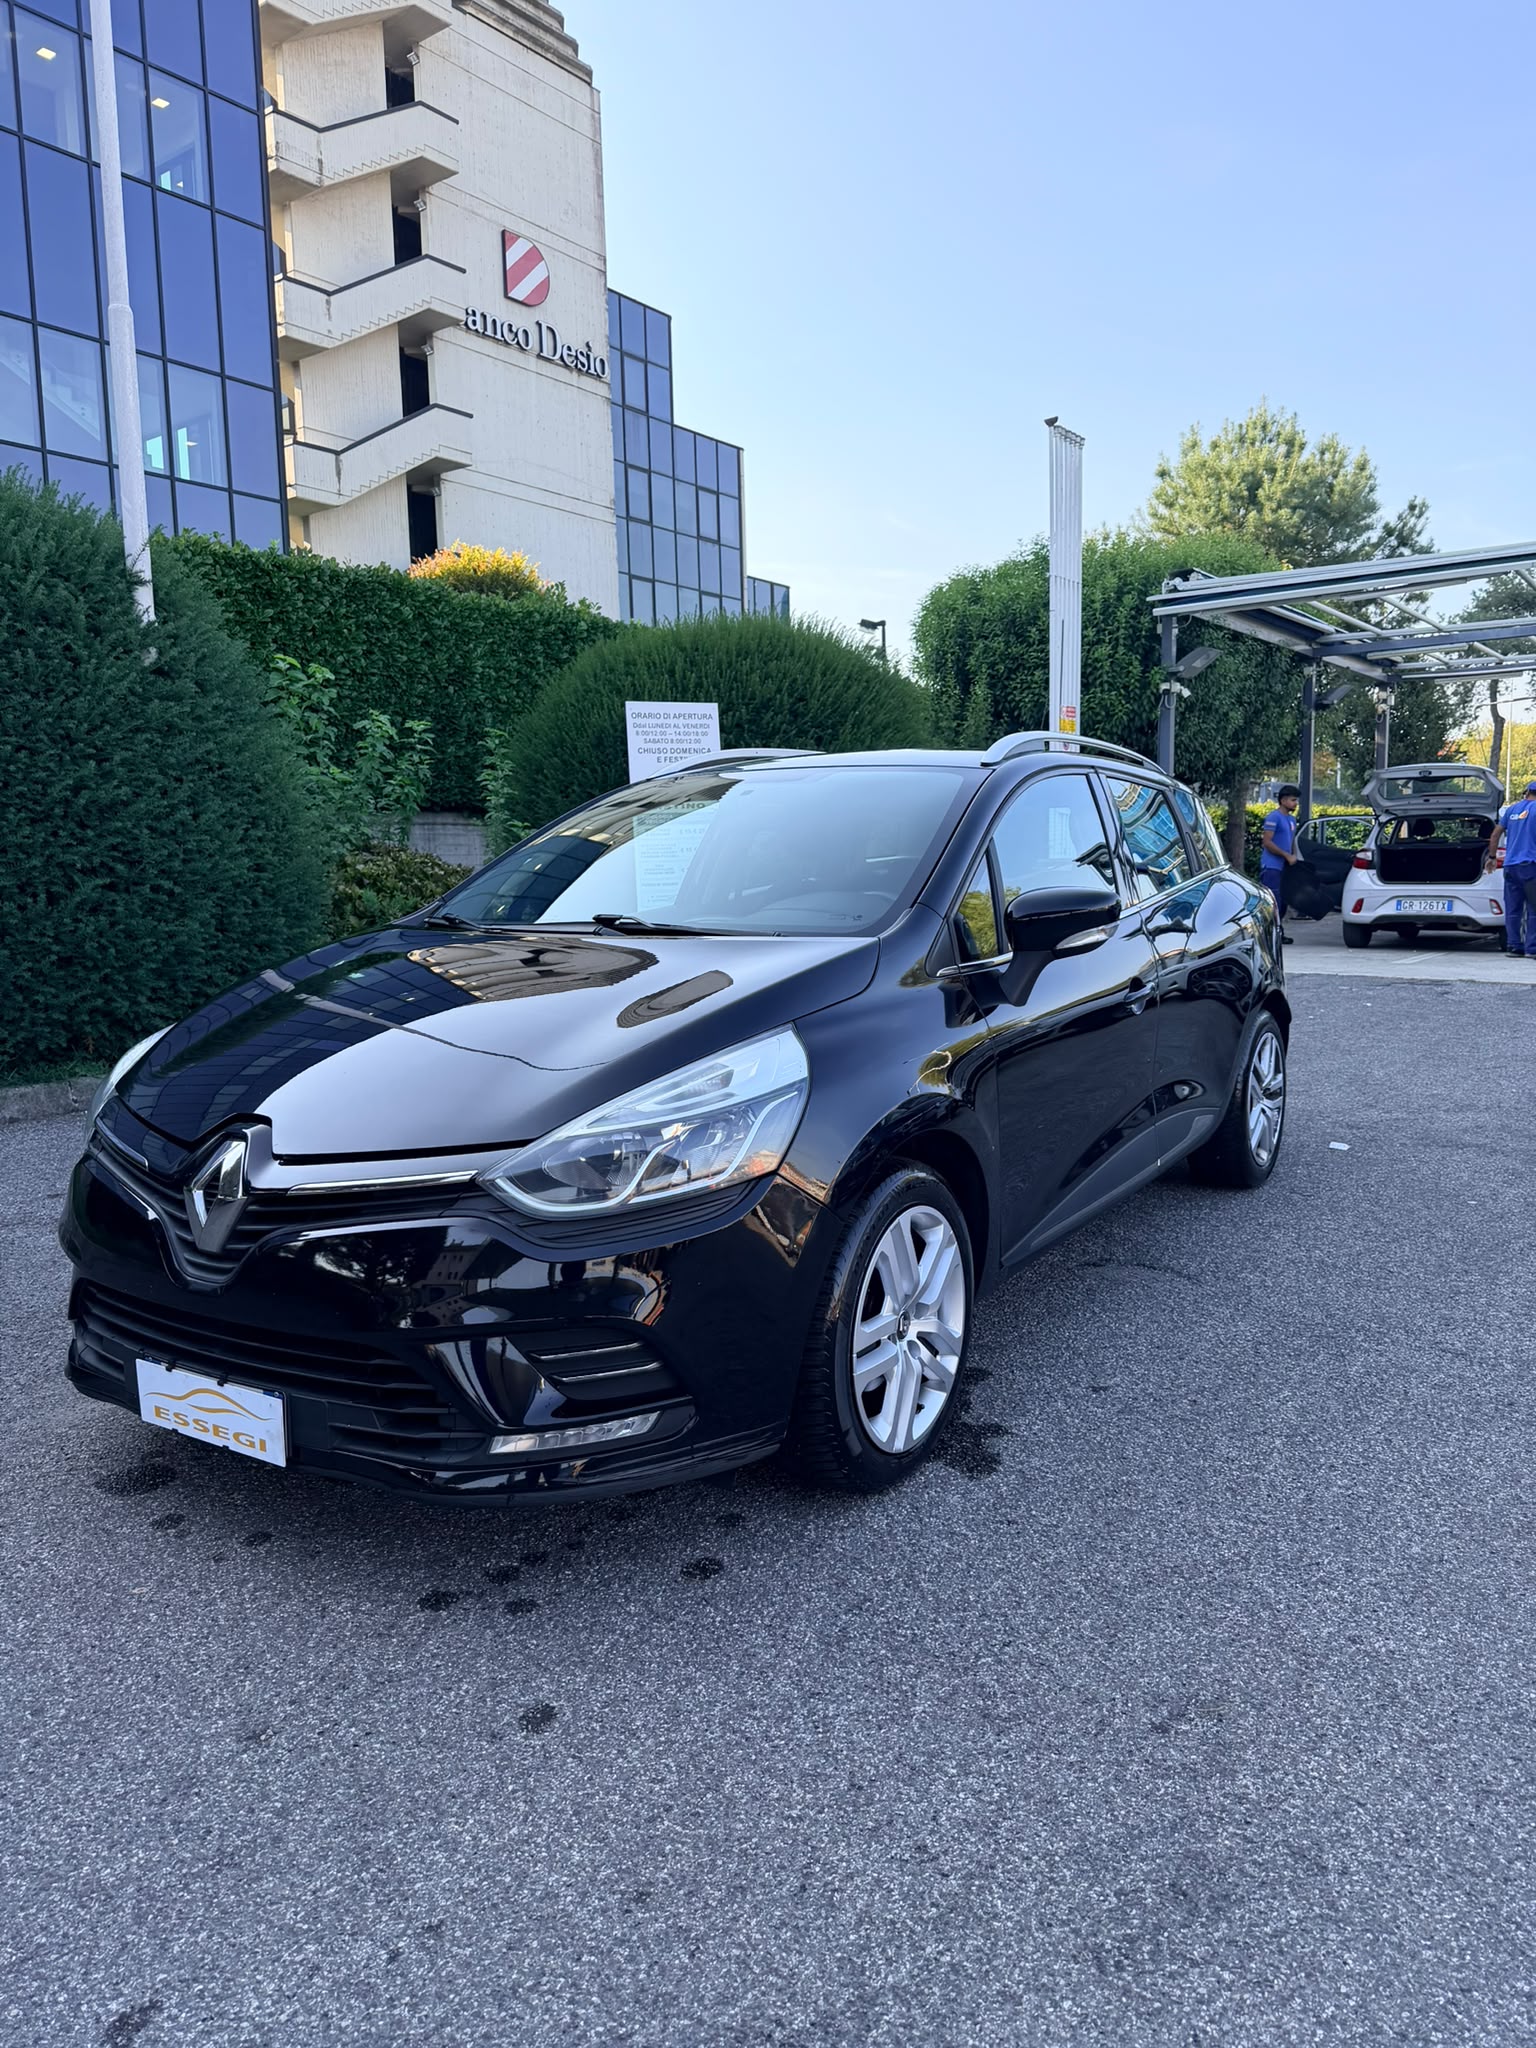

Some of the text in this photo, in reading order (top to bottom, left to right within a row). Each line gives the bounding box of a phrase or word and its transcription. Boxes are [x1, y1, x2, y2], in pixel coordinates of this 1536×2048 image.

[464, 305, 534, 351] anco
[631, 712, 713, 720] ORARIO DI APERTURA
[637, 747, 712, 755] CHIUSO DOMENICA
[1419, 900, 1447, 910] 126TX
[154, 1405, 267, 1453] ESSEGI
